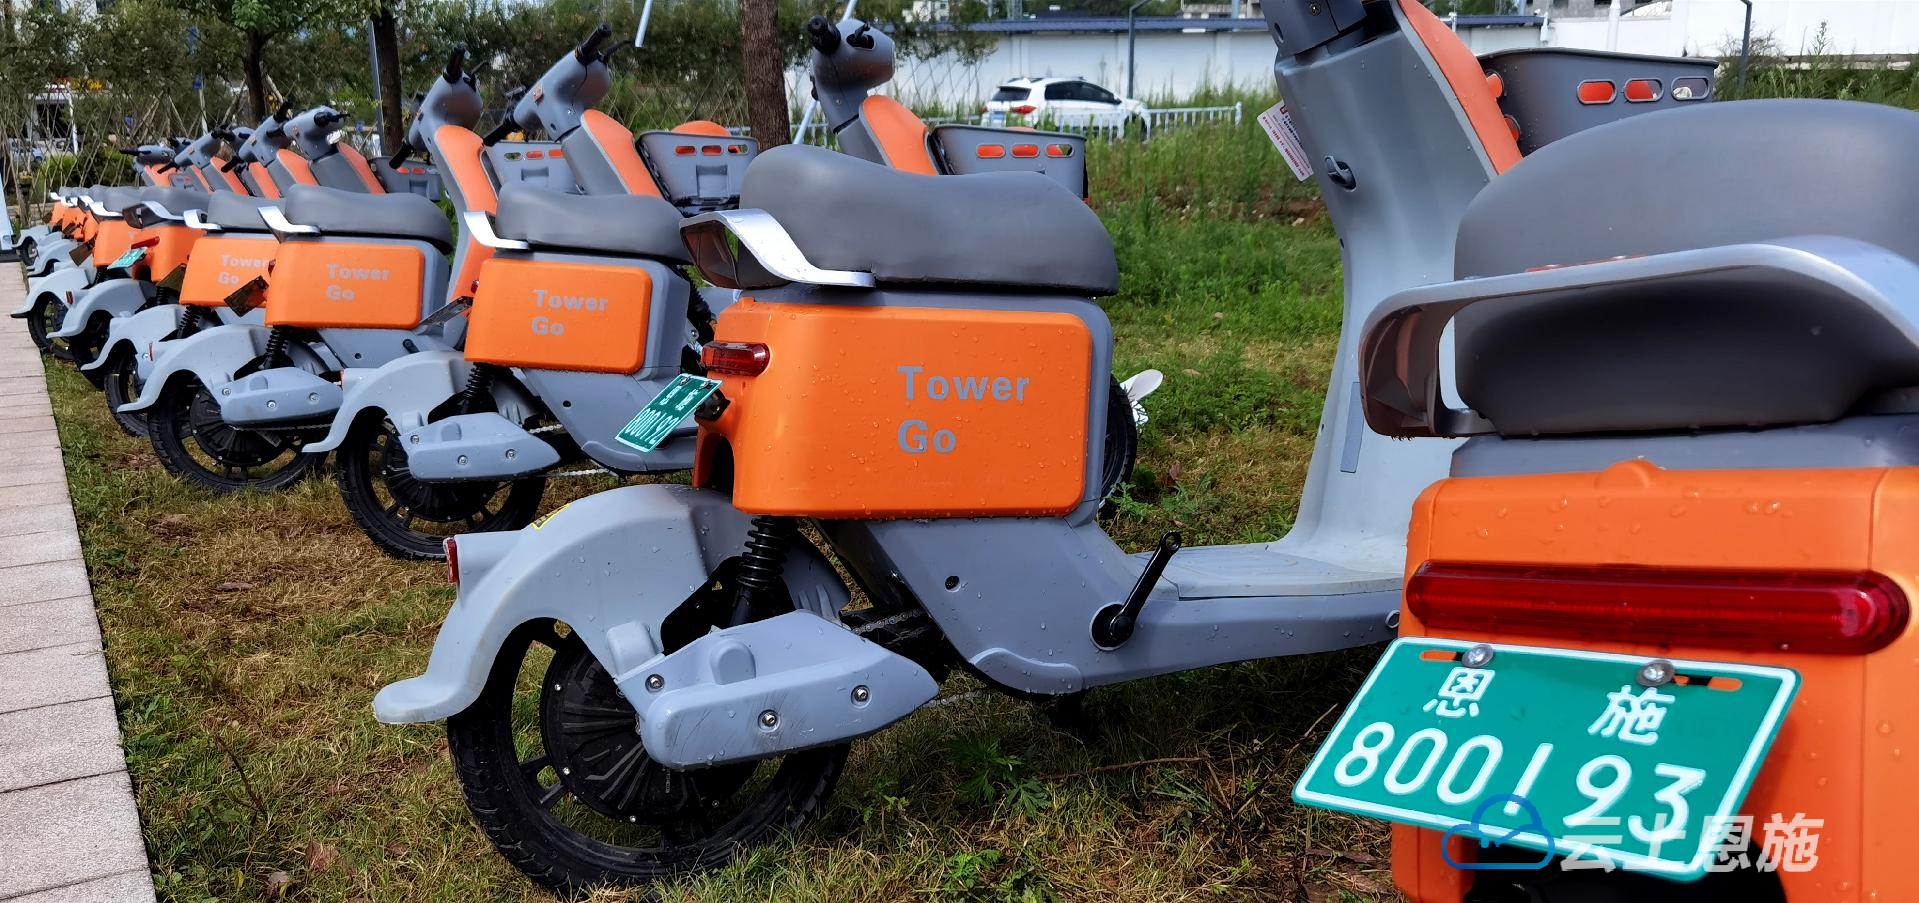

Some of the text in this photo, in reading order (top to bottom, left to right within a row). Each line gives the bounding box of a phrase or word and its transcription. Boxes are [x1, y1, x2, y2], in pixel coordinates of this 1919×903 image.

[218, 271, 240, 285] Go
[327, 263, 391, 281] Tower
[326, 285, 356, 302] Go
[533, 289, 608, 313] Tower
[532, 316, 565, 336] Go
[897, 366, 1030, 401] Tower
[624, 407, 680, 445] 800192
[898, 419, 957, 454] Go
[1333, 721, 1707, 843] 800193
